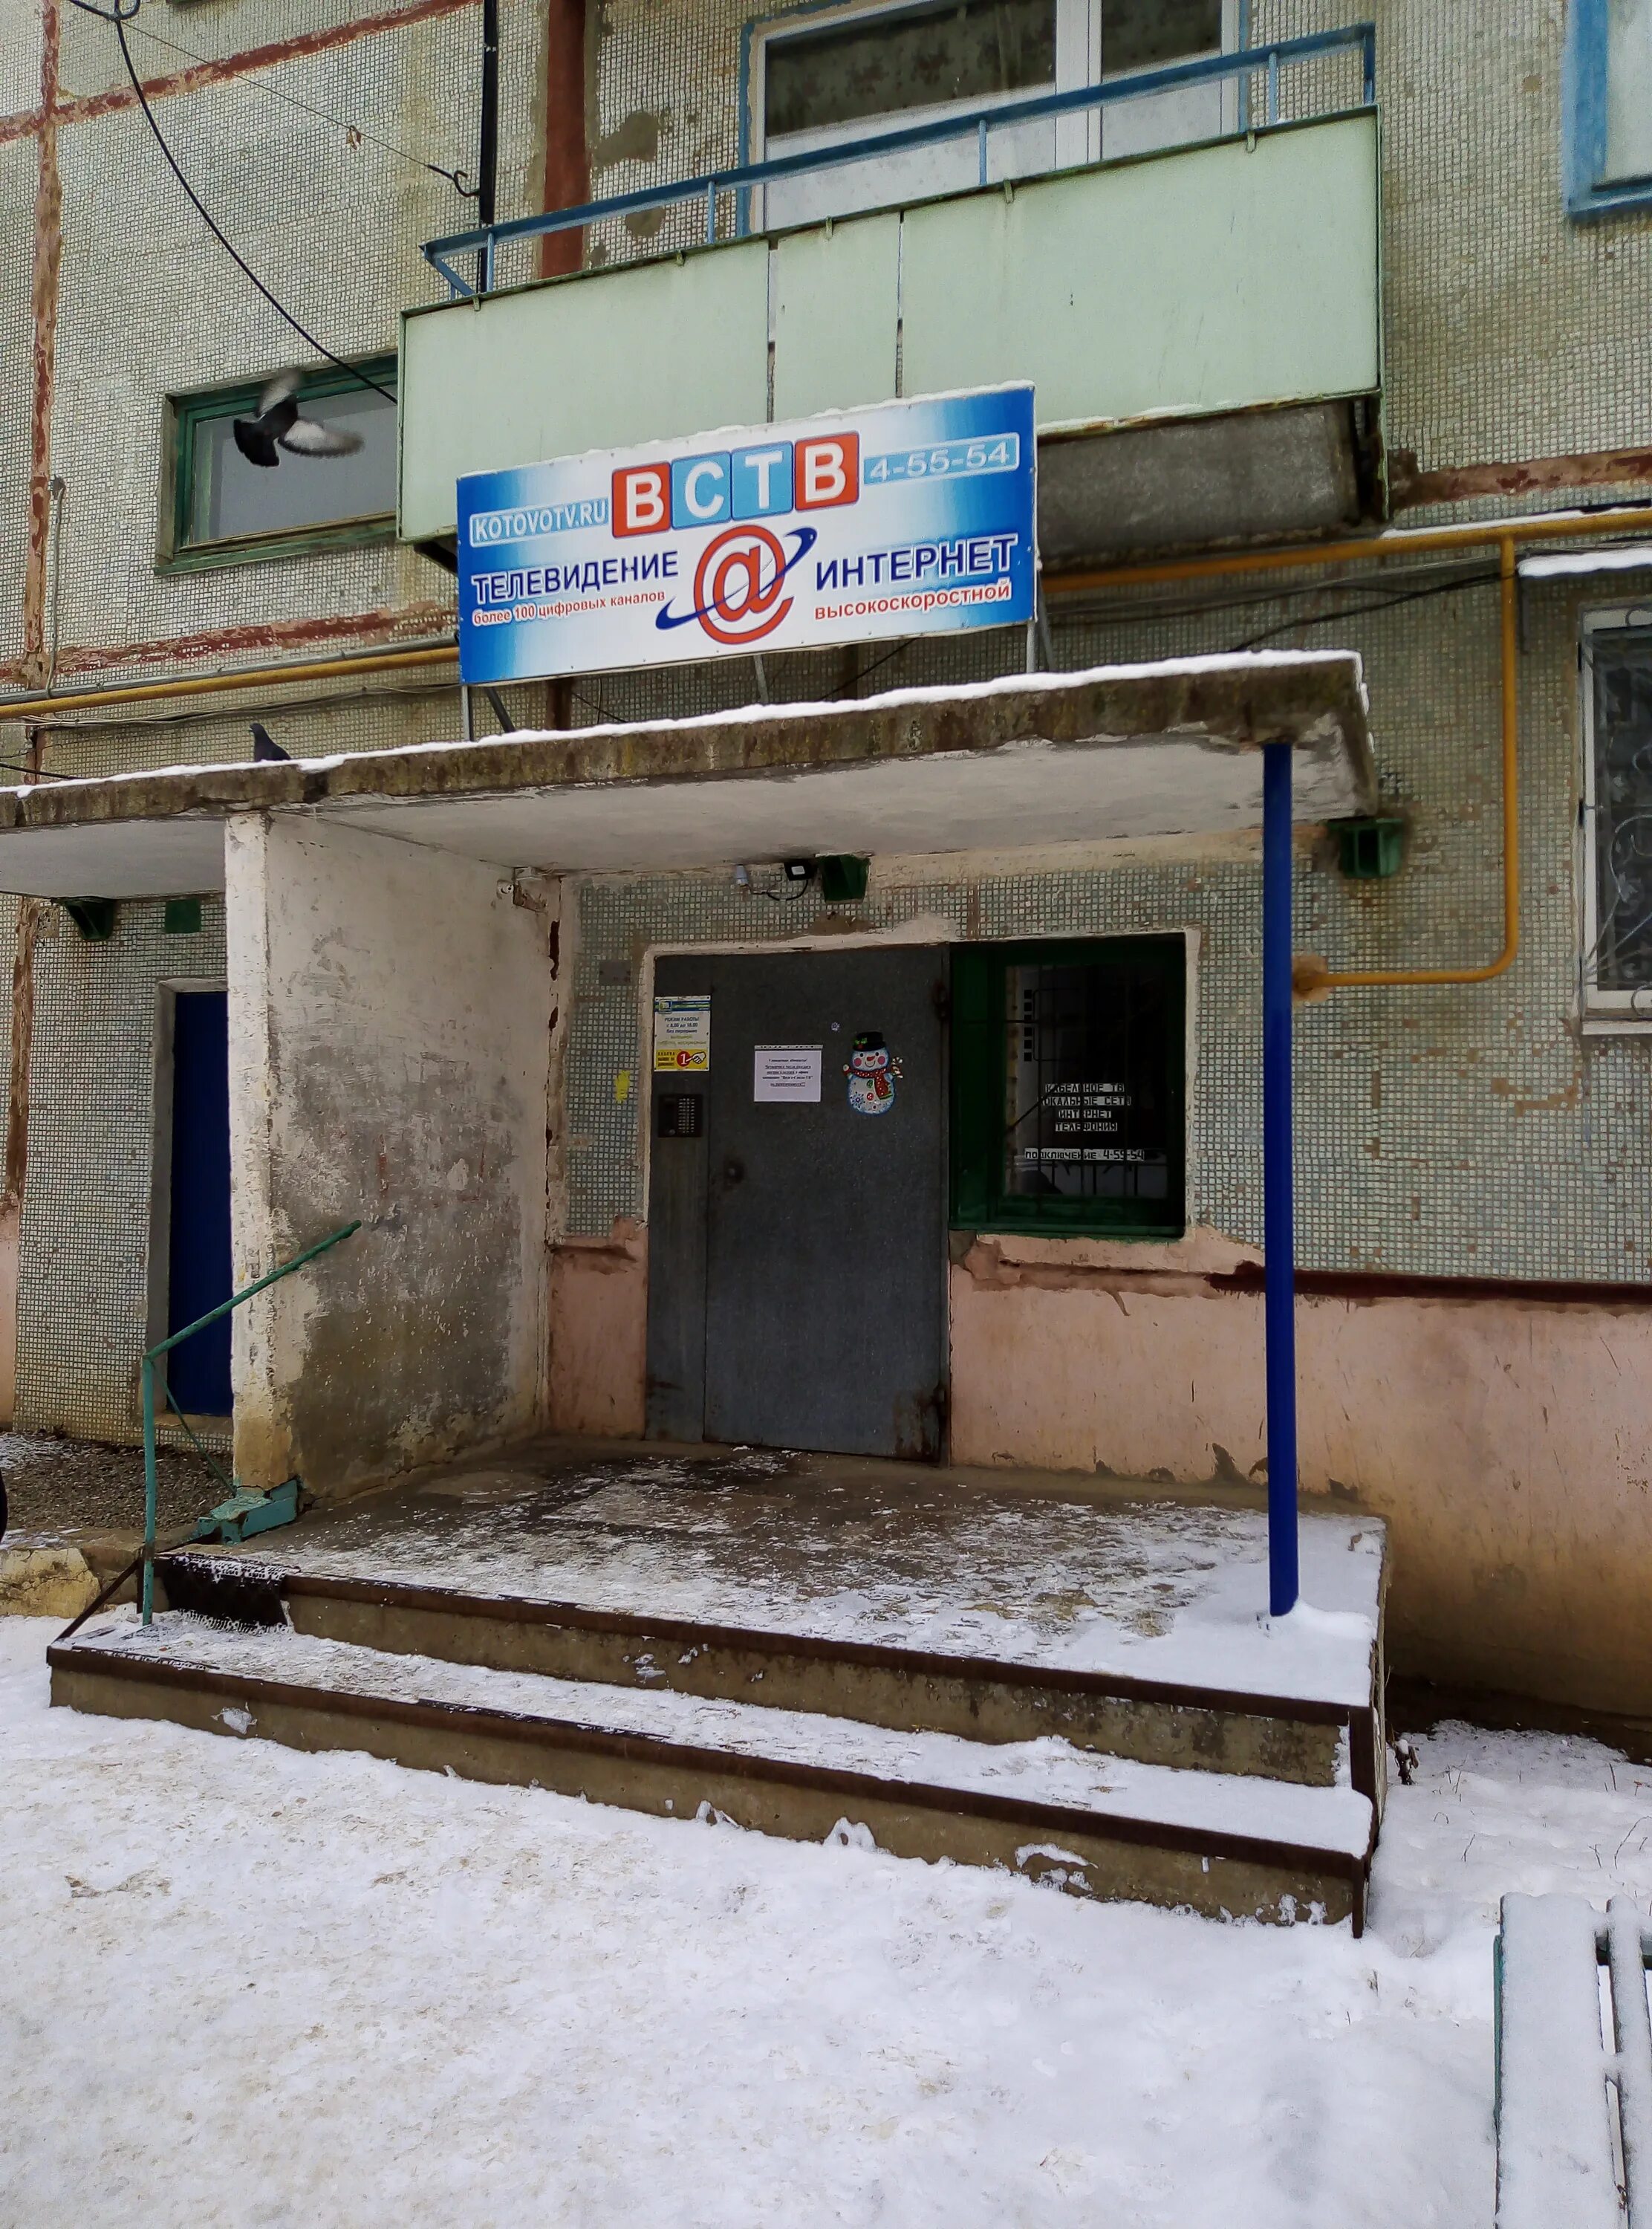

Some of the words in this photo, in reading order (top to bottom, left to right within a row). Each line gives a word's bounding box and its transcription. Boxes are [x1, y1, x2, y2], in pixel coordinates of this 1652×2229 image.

[868, 441, 1011, 485] 4-55-54
[473, 501, 607, 543] KOTOVOTV.RU
[472, 551, 679, 604] ТЕЛЕВИДЕНИЕ
[816, 533, 1018, 591] ИНТЕРНЕТ
[472, 607, 511, 626] более
[515, 604, 536, 621] 100
[539, 597, 607, 621] цифровых
[610, 589, 666, 609] каналов
[814, 582, 1012, 621] высокоскоростной
[1046, 1083, 1104, 1093] КАБЕЛНОЕ
